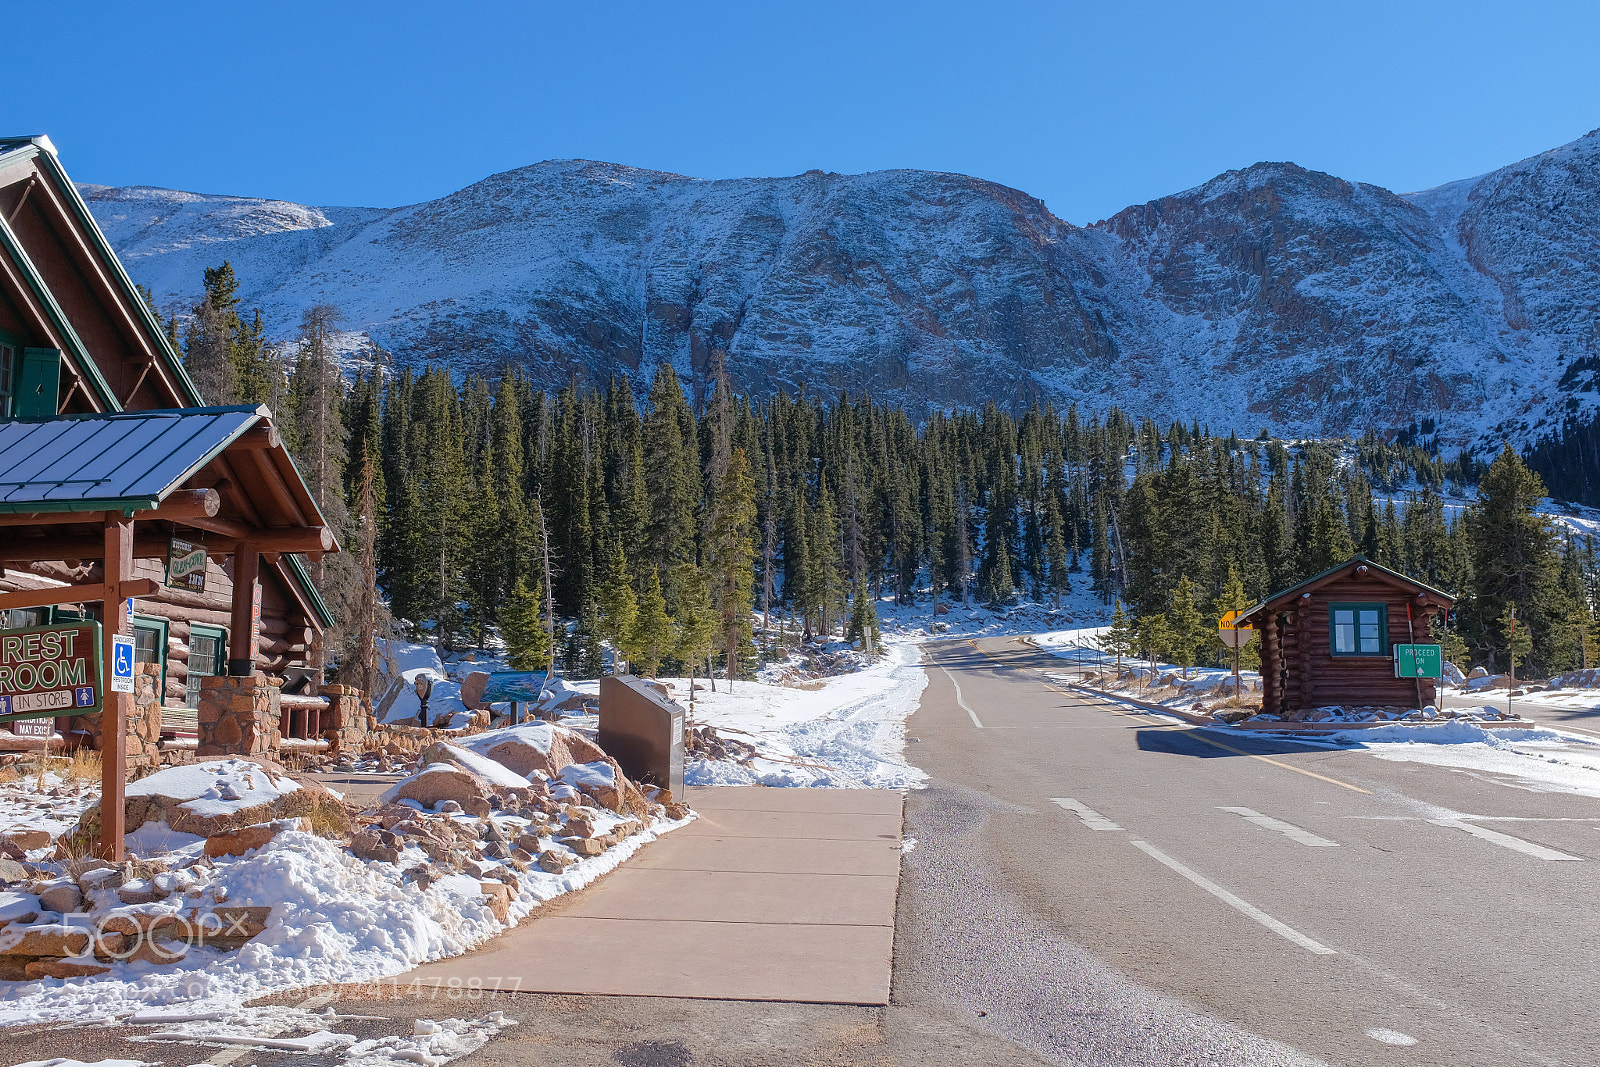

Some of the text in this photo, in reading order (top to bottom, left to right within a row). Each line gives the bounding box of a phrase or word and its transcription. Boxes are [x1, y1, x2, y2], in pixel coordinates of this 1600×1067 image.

[251, 588, 261, 656] OPEN
[2, 629, 79, 664] REST
[1405, 648, 1435, 657] PROCEED
[1415, 657, 1425, 665] ON
[0, 657, 87, 694] ROOM
[18, 691, 68, 710] IN STORE
[19, 724, 51, 735] MAY EXIST
